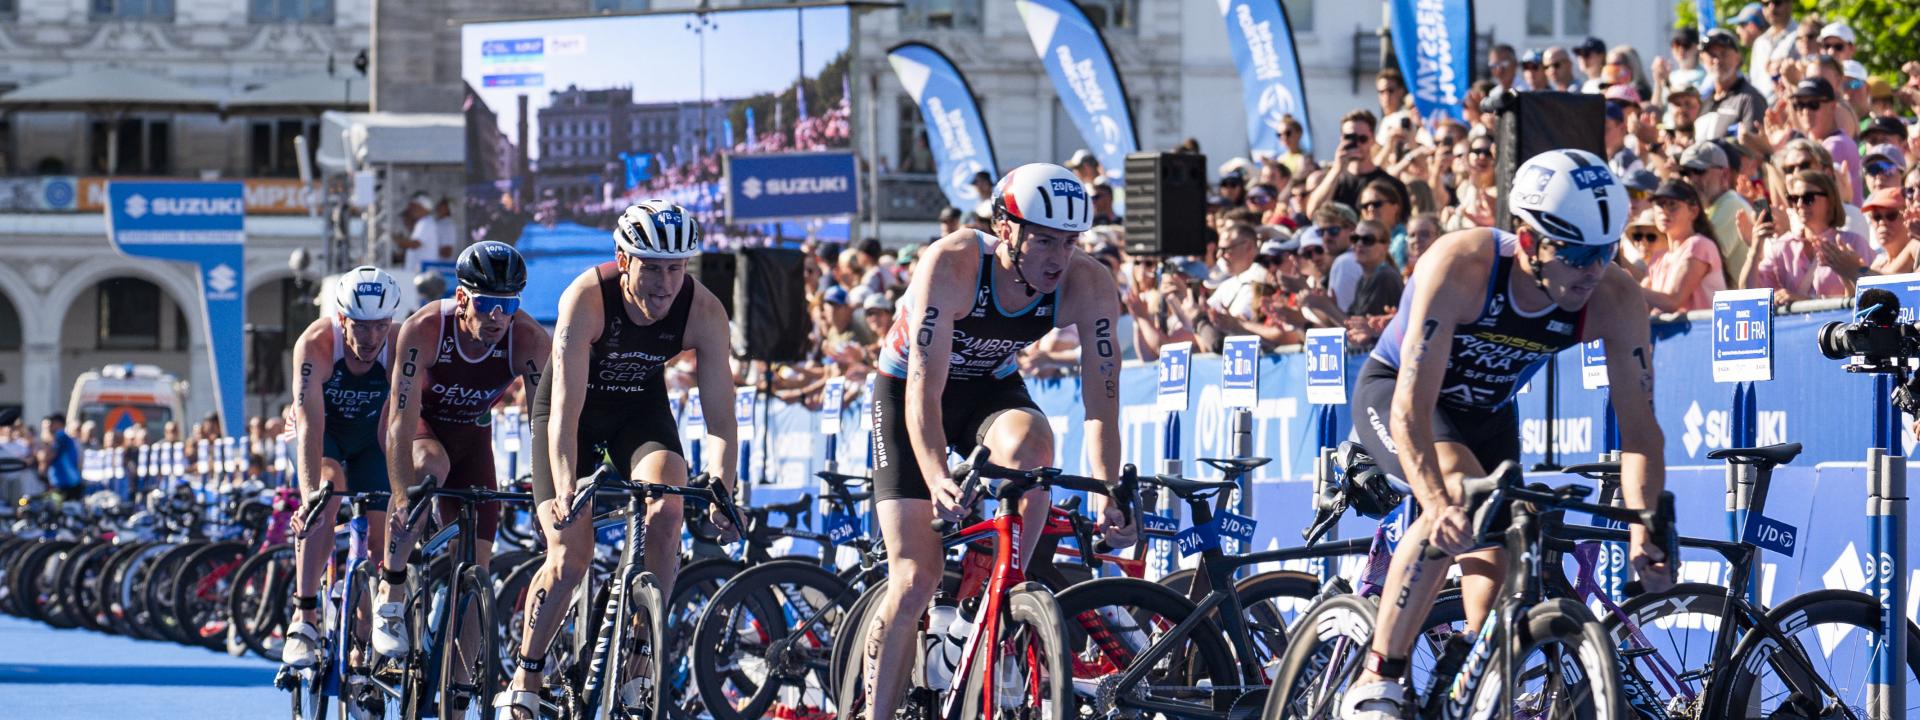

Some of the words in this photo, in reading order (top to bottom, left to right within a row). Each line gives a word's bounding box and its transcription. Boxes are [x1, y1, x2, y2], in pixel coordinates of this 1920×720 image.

[766, 176, 848, 195] SUZUKI
[152, 198, 243, 216] SUZUKI
[917, 306, 939, 347] 20
[1424, 319, 1439, 341] 1
[1751, 320, 1766, 340] FRA
[1095, 318, 1113, 358] 20
[402, 348, 419, 378] 10
[621, 350, 666, 362] SUZUKI
[1633, 347, 1647, 370] 1
[301, 362, 313, 377] 6
[599, 369, 647, 382] GER
[431, 382, 497, 401] DÉVAY
[1705, 409, 1787, 449] SUUKI
[1221, 517, 1240, 533] 3/D
[1010, 523, 1021, 570] CUBE
[584, 578, 622, 690] CANYON
